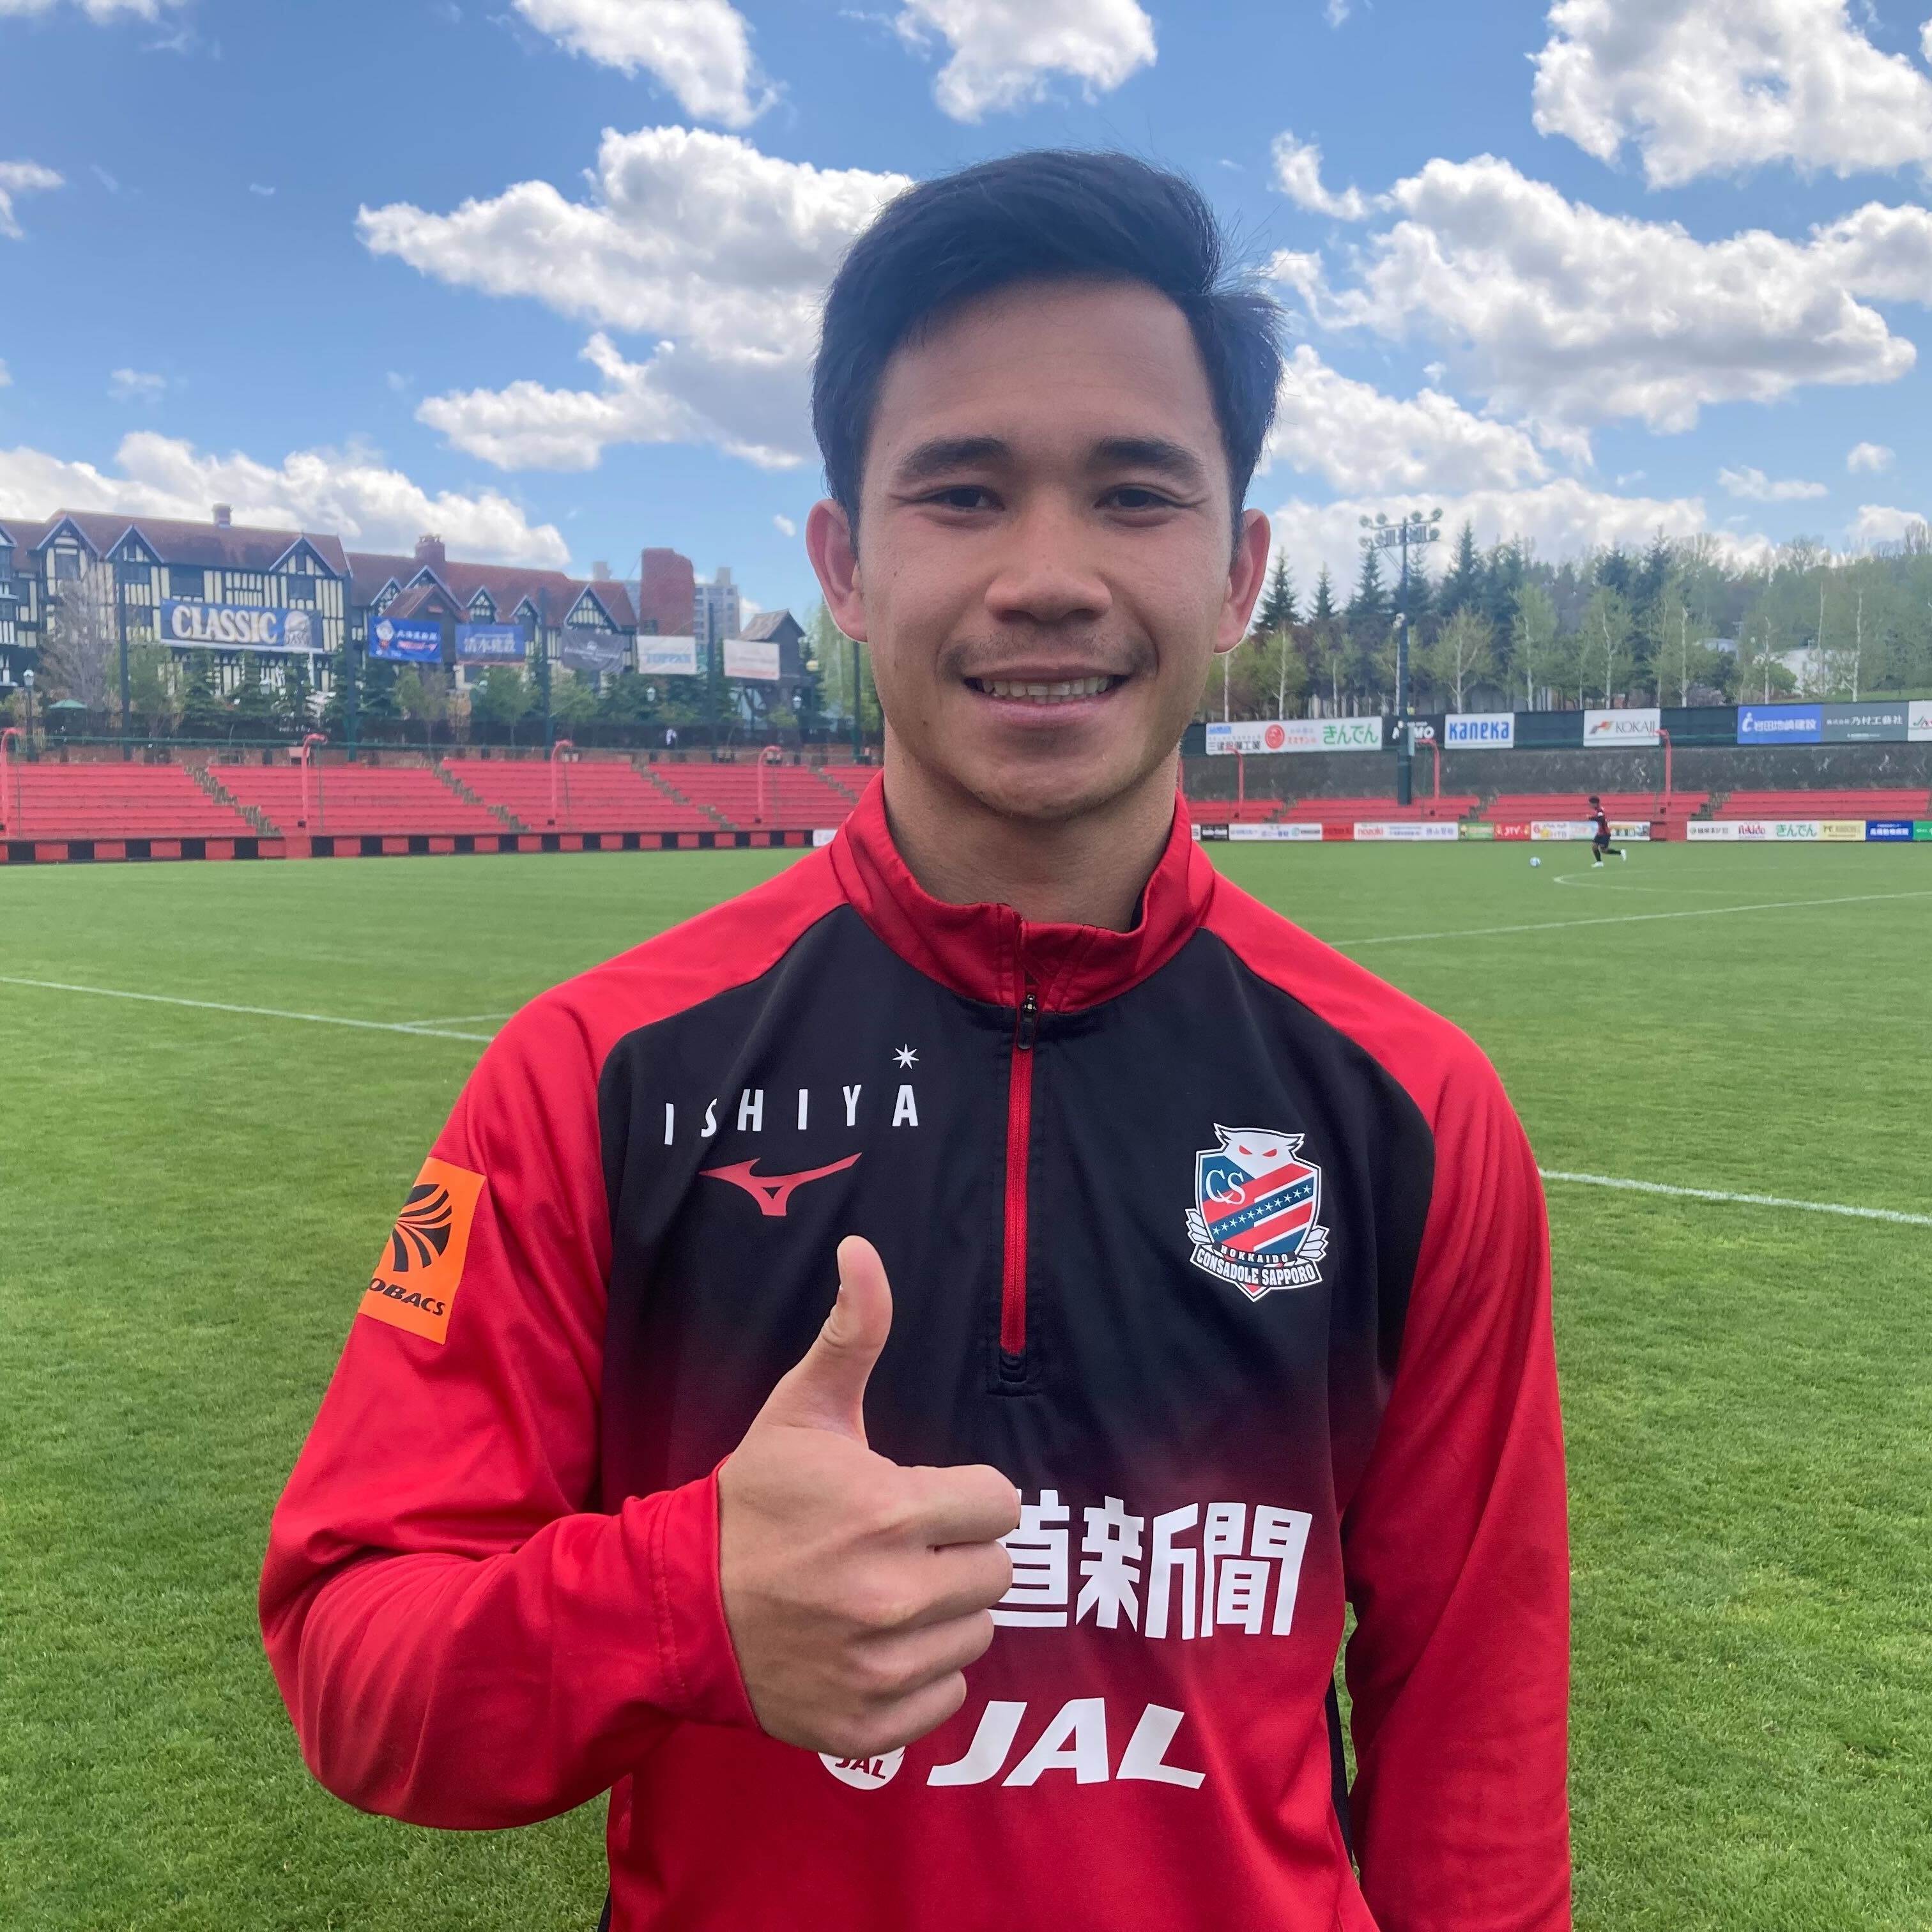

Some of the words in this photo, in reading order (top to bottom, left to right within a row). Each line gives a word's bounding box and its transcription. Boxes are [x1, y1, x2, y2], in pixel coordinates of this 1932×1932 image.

[172, 605, 276, 644] CLASSIC
[1322, 723, 1379, 745] きんでん
[1776, 824, 1818, 838] きんでん
[664, 1084, 918, 1146] ISHIYA
[1205, 1169, 1246, 1205] CS
[1197, 1248, 1259, 1284] CONSADOLE
[1261, 1264, 1316, 1285] SAPPORO
[1221, 1245, 1288, 1263] HOKKAIDO
[369, 1277, 446, 1316] OBACS
[926, 1697, 1206, 1790] JAL
